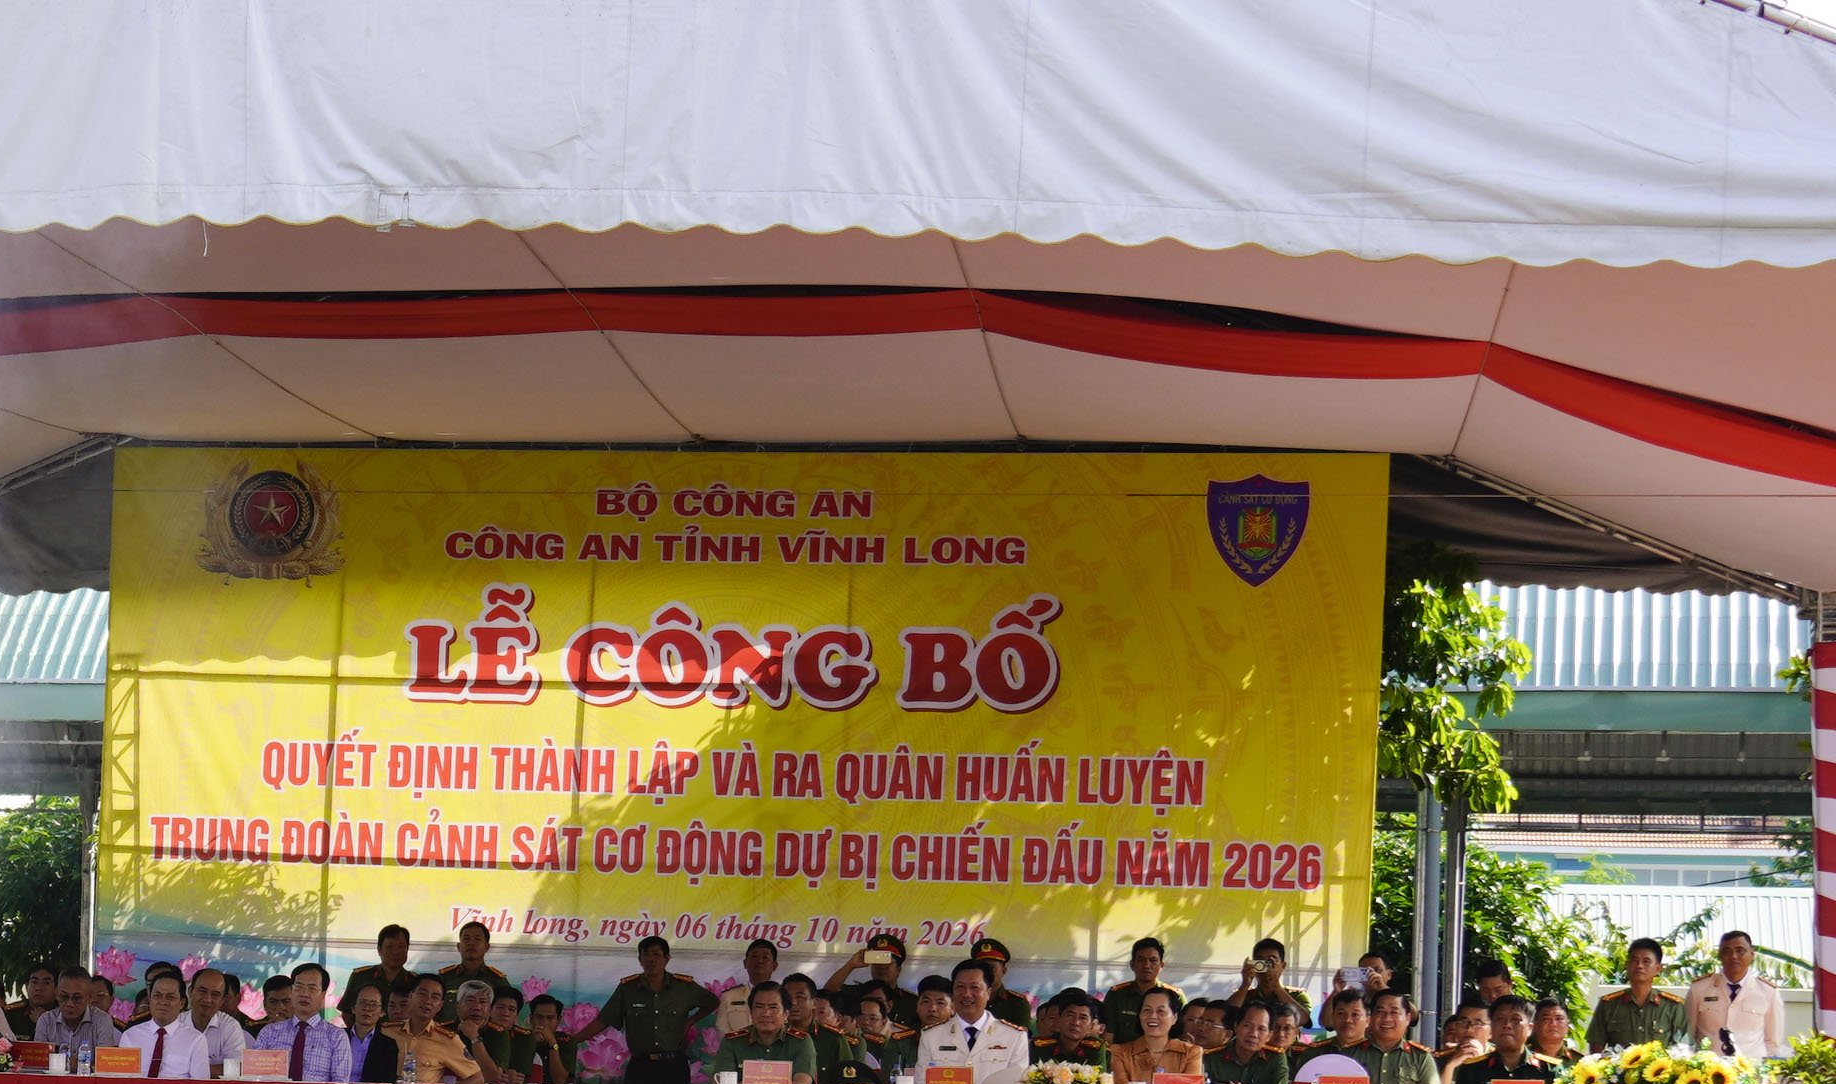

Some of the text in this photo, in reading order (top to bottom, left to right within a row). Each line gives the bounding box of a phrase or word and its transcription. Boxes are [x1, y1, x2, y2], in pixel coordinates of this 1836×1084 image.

[596, 483, 872, 521] BỘ CÔNG AN
[445, 525, 1025, 565] CÔNG AN TỈNH VĨNH LONG
[404, 583, 1062, 713] LỄ CÔNG BỐ
[263, 729, 1205, 816] QUYẾT ĐỊNH THÀNH LẬP VÀ RA QUÂN HUẤN LUYỆN
[150, 808, 1322, 890] TRUNG ĐOÀN CẢNH SÁT CƠ ĐỘNG DỰ BỊ CHIẾN ĐẤU NĂM 2026
[600, 912, 666, 944] ngày
[675, 913, 708, 940] 06
[715, 915, 796, 948] tháng
[805, 917, 838, 943] 10
[846, 918, 908, 944] năm
[916, 920, 986, 946] 2026
